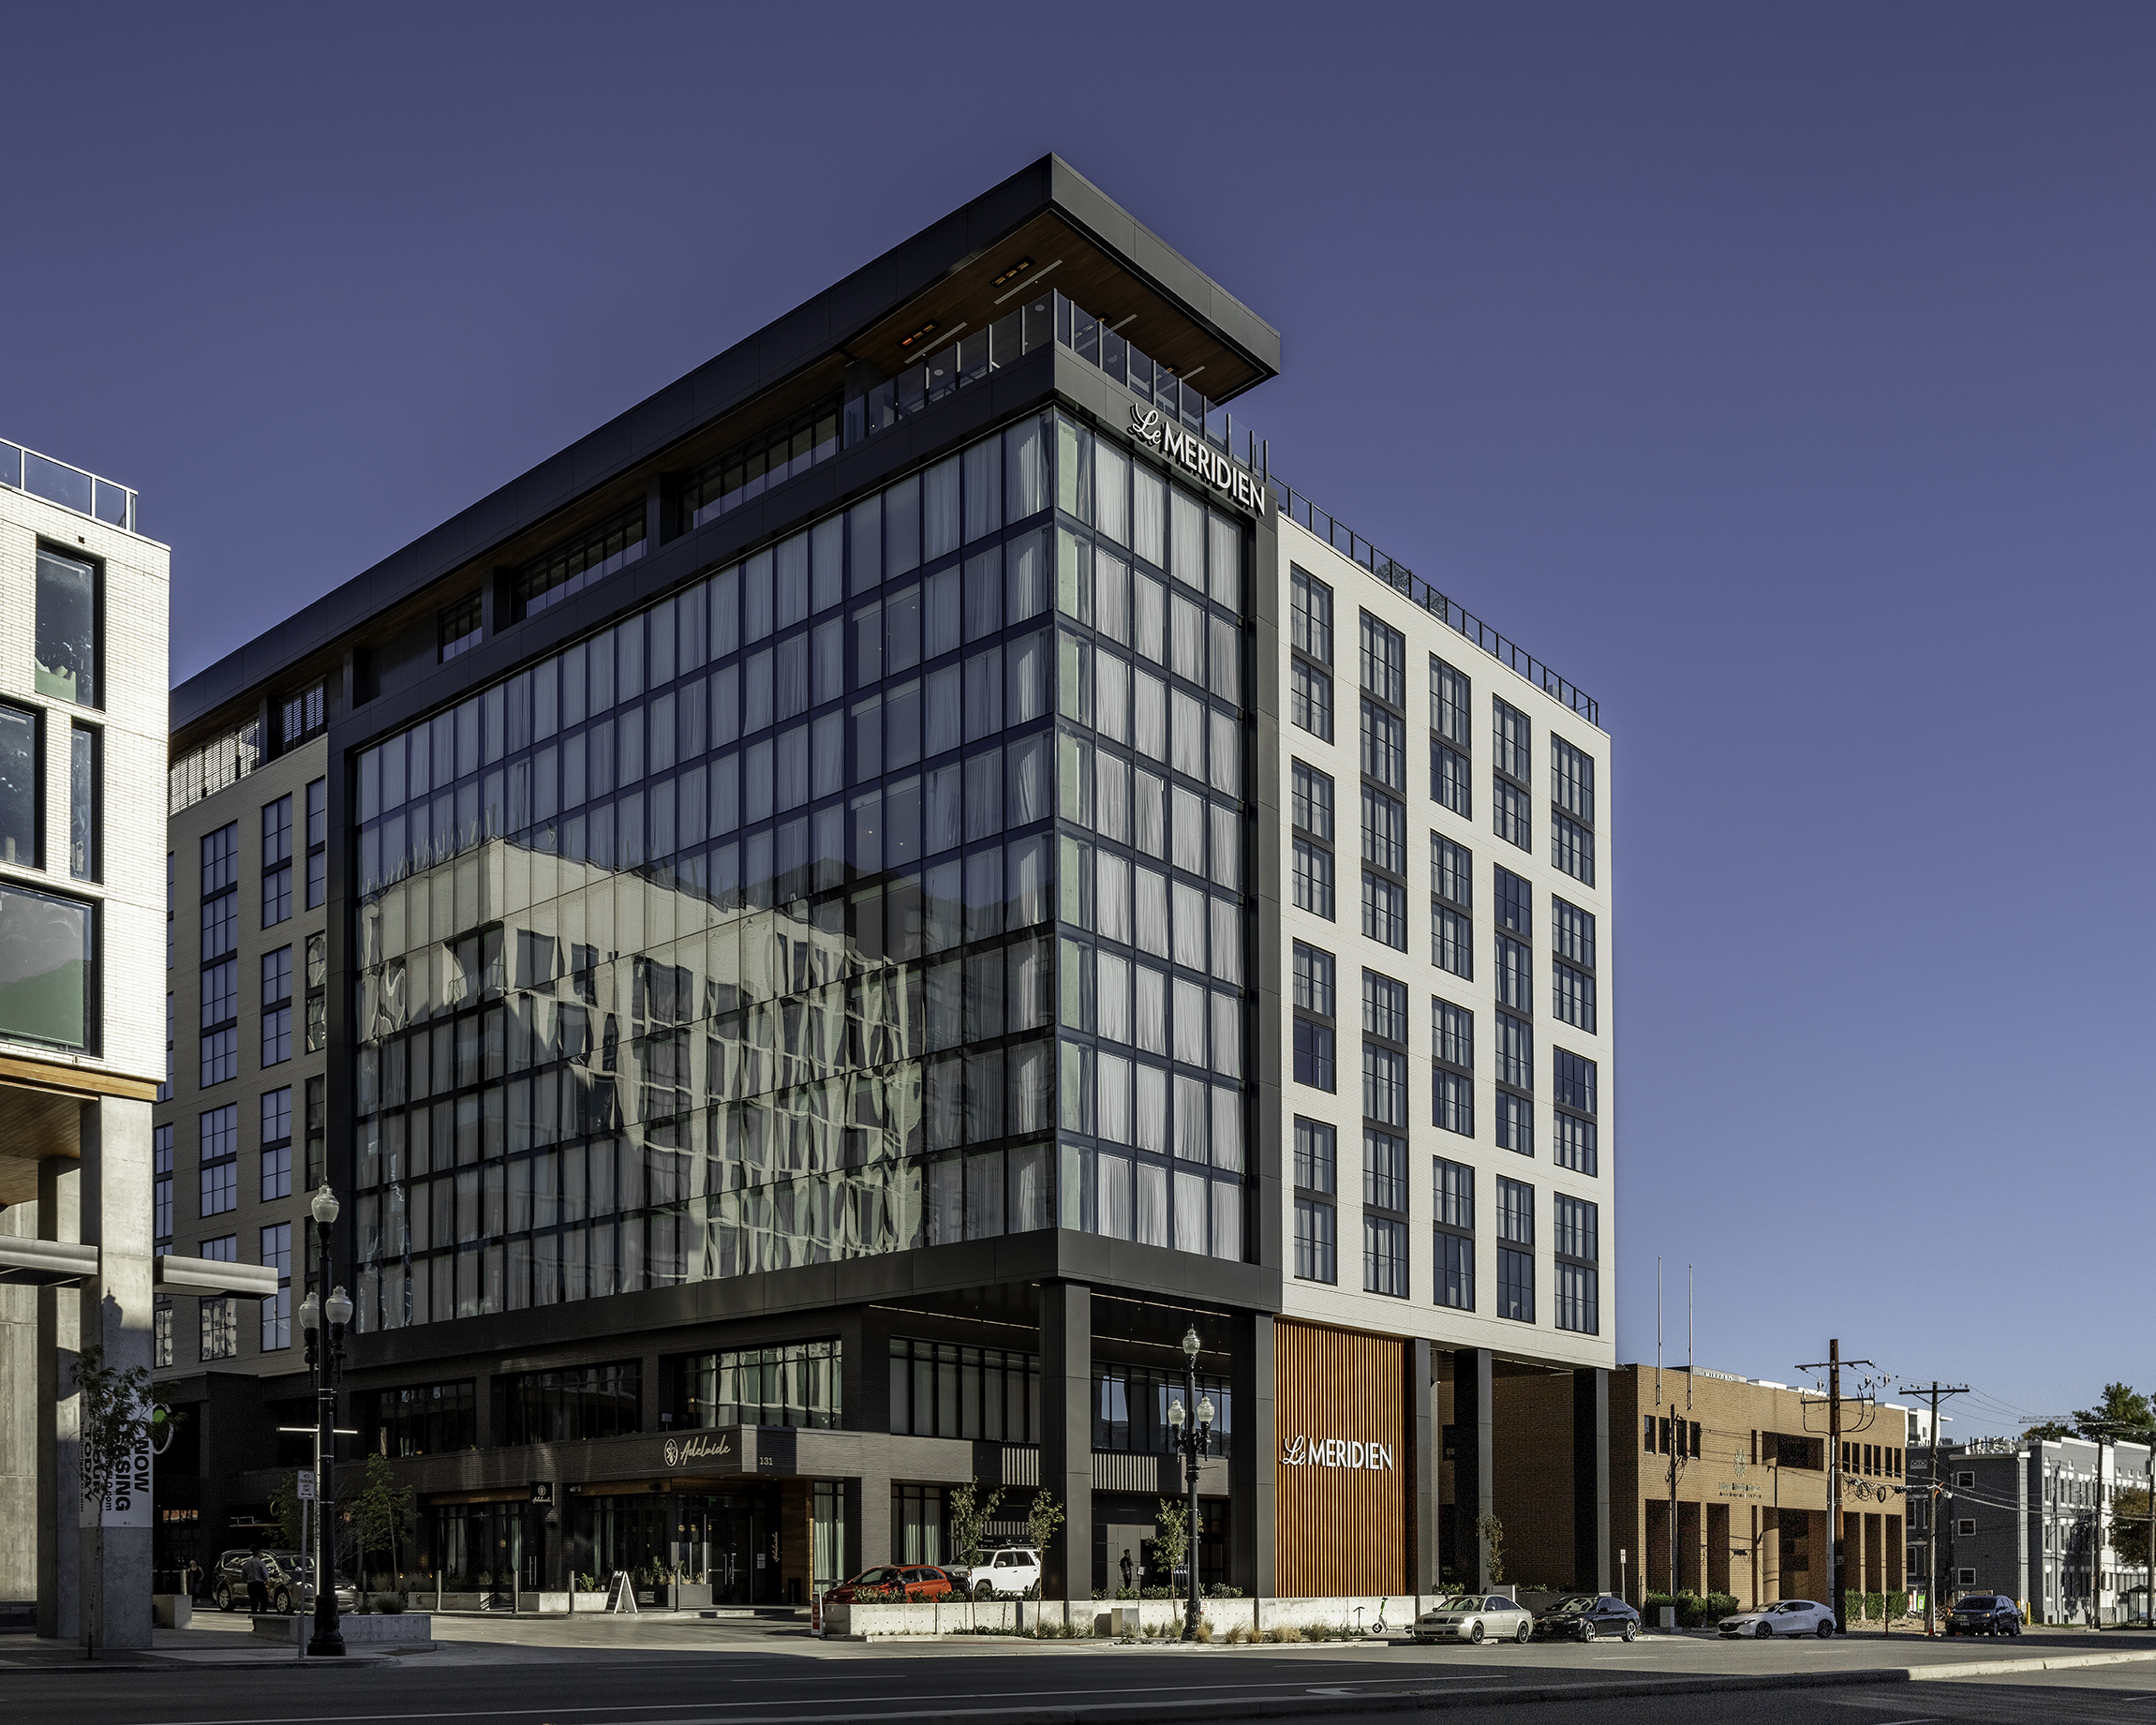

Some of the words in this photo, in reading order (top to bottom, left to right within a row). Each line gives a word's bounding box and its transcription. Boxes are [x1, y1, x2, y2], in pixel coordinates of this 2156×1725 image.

[1132, 402, 1162, 444] Le
[1162, 421, 1265, 517] MERIDIEN
[115, 1420, 130, 1511] ASING
[134, 1439, 149, 1493] NOW
[679, 1434, 732, 1465] Adelaide
[759, 1456, 773, 1466] 131
[1282, 1435, 1307, 1465] Le
[1307, 1436, 1393, 1470] MERIDIEN
